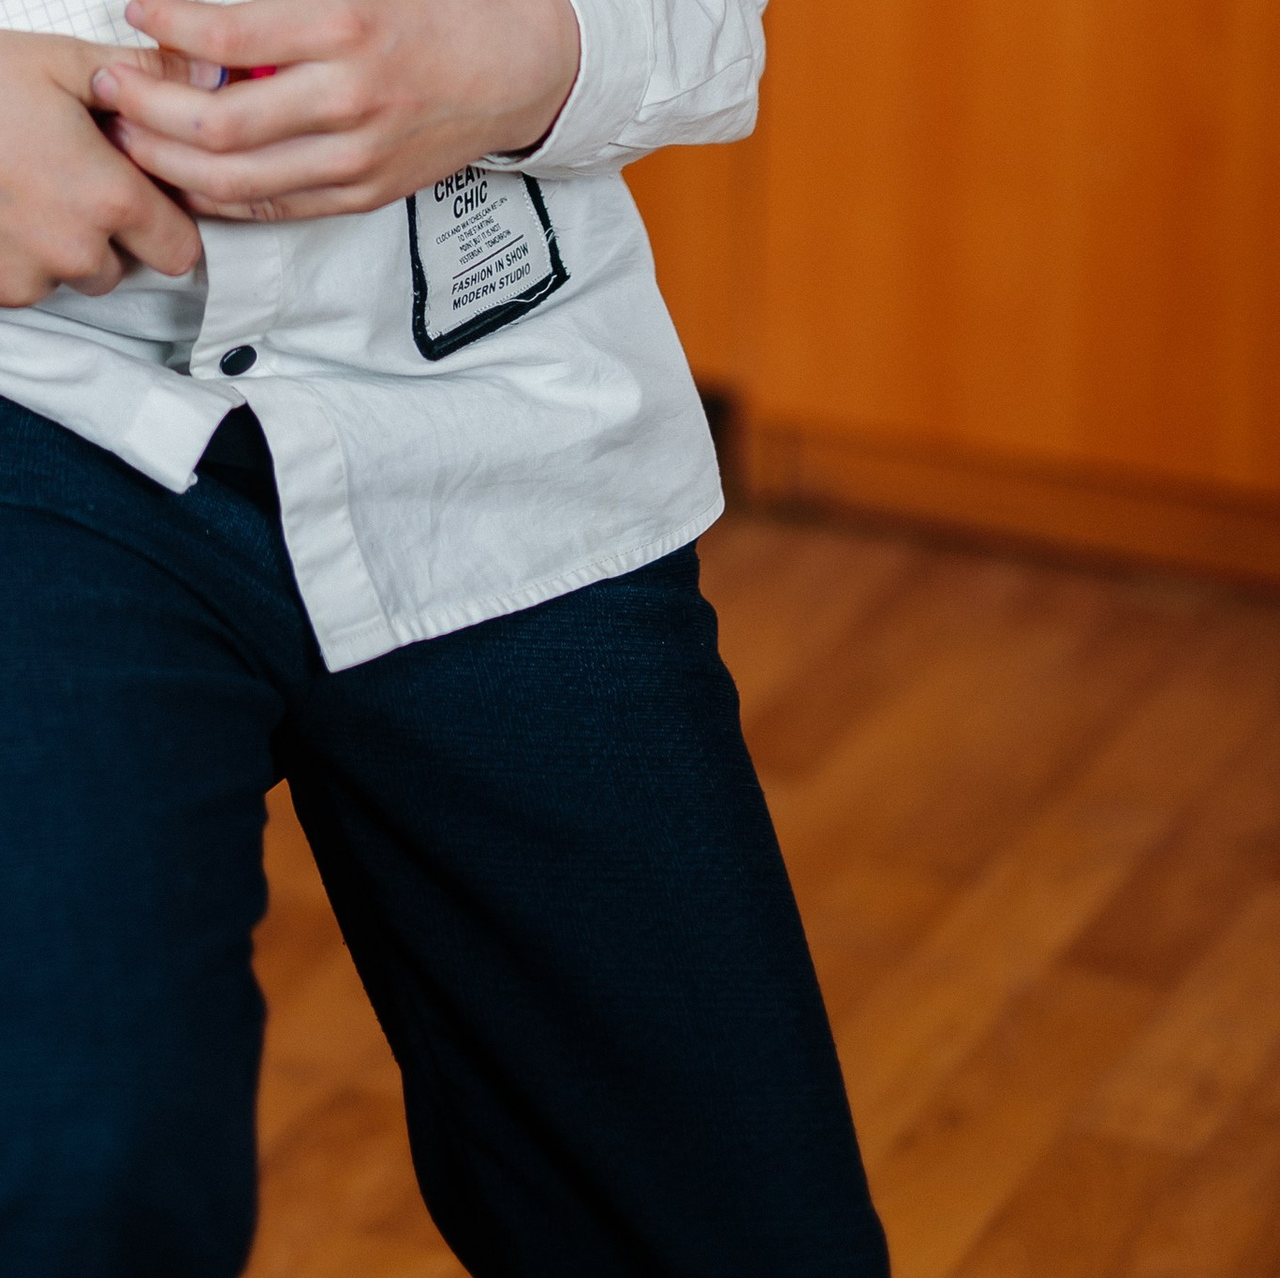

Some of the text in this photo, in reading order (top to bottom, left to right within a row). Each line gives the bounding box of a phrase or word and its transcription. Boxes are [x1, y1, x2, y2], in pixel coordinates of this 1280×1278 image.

[453, 180, 488, 219] CHIC
[451, 242, 529, 295] FASHION IN SHOW
[452, 262, 531, 311] MODERN STUDIO
